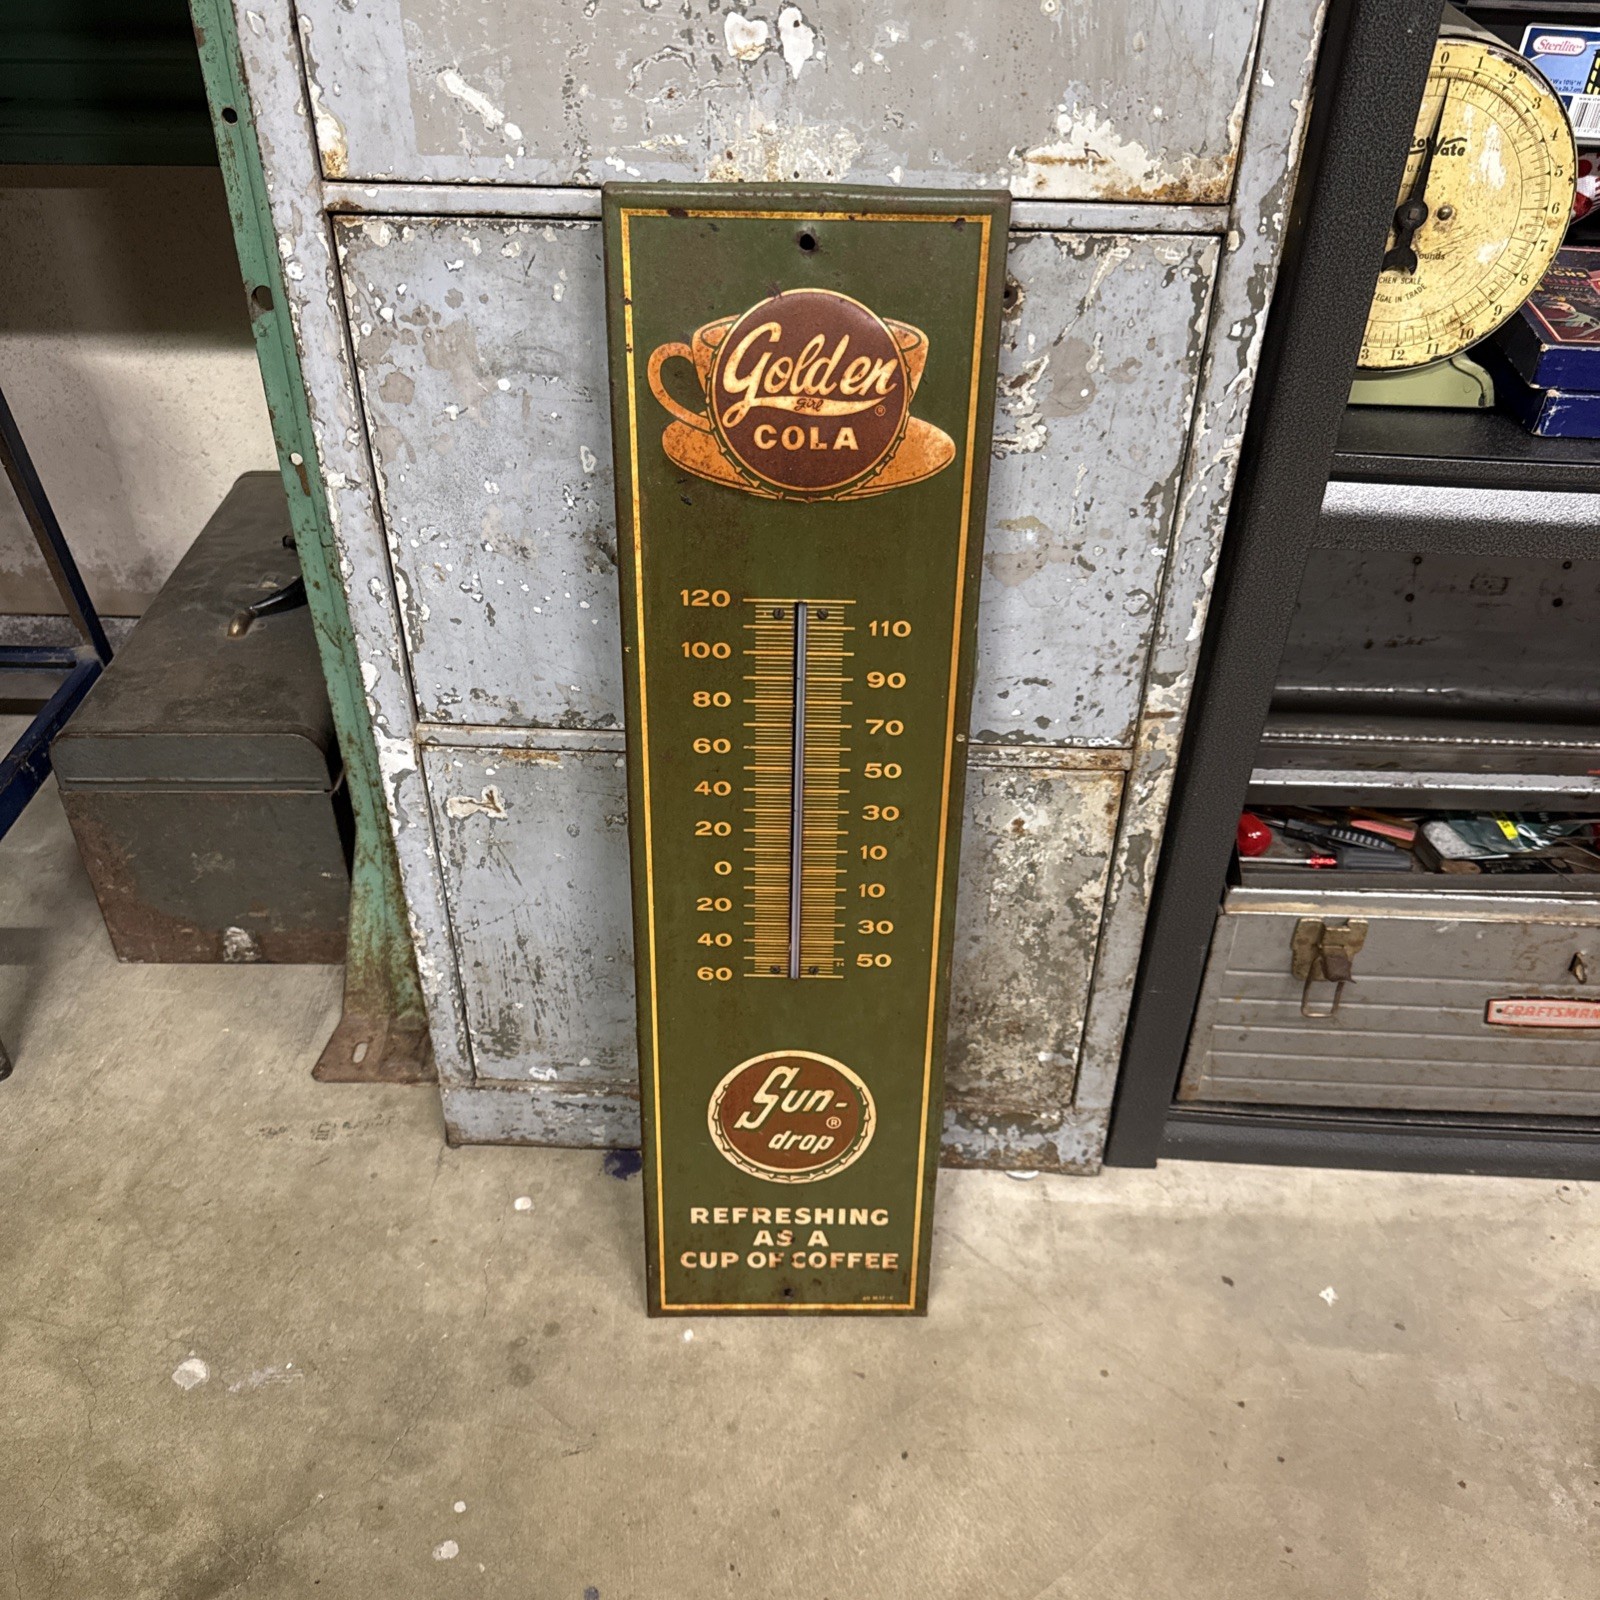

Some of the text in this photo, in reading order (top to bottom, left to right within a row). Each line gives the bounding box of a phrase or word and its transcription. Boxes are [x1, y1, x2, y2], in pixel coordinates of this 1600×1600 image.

[1538, 39, 1579, 52] Sterilite
[1440, 51, 1450, 65] 0
[1475, 56, 1484, 69] 1
[1507, 70, 1518, 85] 2
[1532, 97, 1542, 110] 3
[1549, 127, 1559, 141] 4
[1554, 164, 1564, 178] 5
[1551, 202, 1560, 214] 6
[1540, 239, 1548, 252] 7
[1418, 252, 1446, 260] ounds
[1379, 276, 1422, 285] CHEN SCALE
[1520, 274, 1529, 286] 8
[1405, 283, 1427, 300] TRADE
[1494, 304, 1503, 317] 9
[1459, 328, 1475, 341] 10
[1361, 348, 1406, 361] 3 12
[1426, 343, 1441, 355] 11
[722, 321, 899, 428] Golden
[753, 424, 859, 451] COLA
[680, 589, 731, 608] 120
[868, 620, 912, 638] 110
[681, 641, 732, 660] 100
[866, 671, 907, 689] 90
[692, 691, 732, 708] 80
[865, 718, 905, 736] 70
[692, 738, 732, 754] 60
[864, 762, 902, 779] 50
[694, 781, 732, 796] 40
[862, 804, 900, 821] 30
[694, 821, 732, 836] 20
[860, 845, 888, 860] 10
[714, 861, 733, 876] 0
[858, 883, 886, 898] 10
[696, 897, 733, 912] 20
[857, 920, 894, 934] 30
[697, 933, 733, 947] 40
[856, 953, 892, 968] 50
[697, 967, 733, 981] 60
[1502, 1005, 1600, 1019] CRAFTSMAN
[733, 1065, 848, 1129] Sun-
[768, 1130, 835, 1154] drop
[690, 1207, 889, 1226] REFRESHING
[753, 1230, 829, 1247] AS A
[680, 1251, 899, 1270] CUP OF COFFEE
